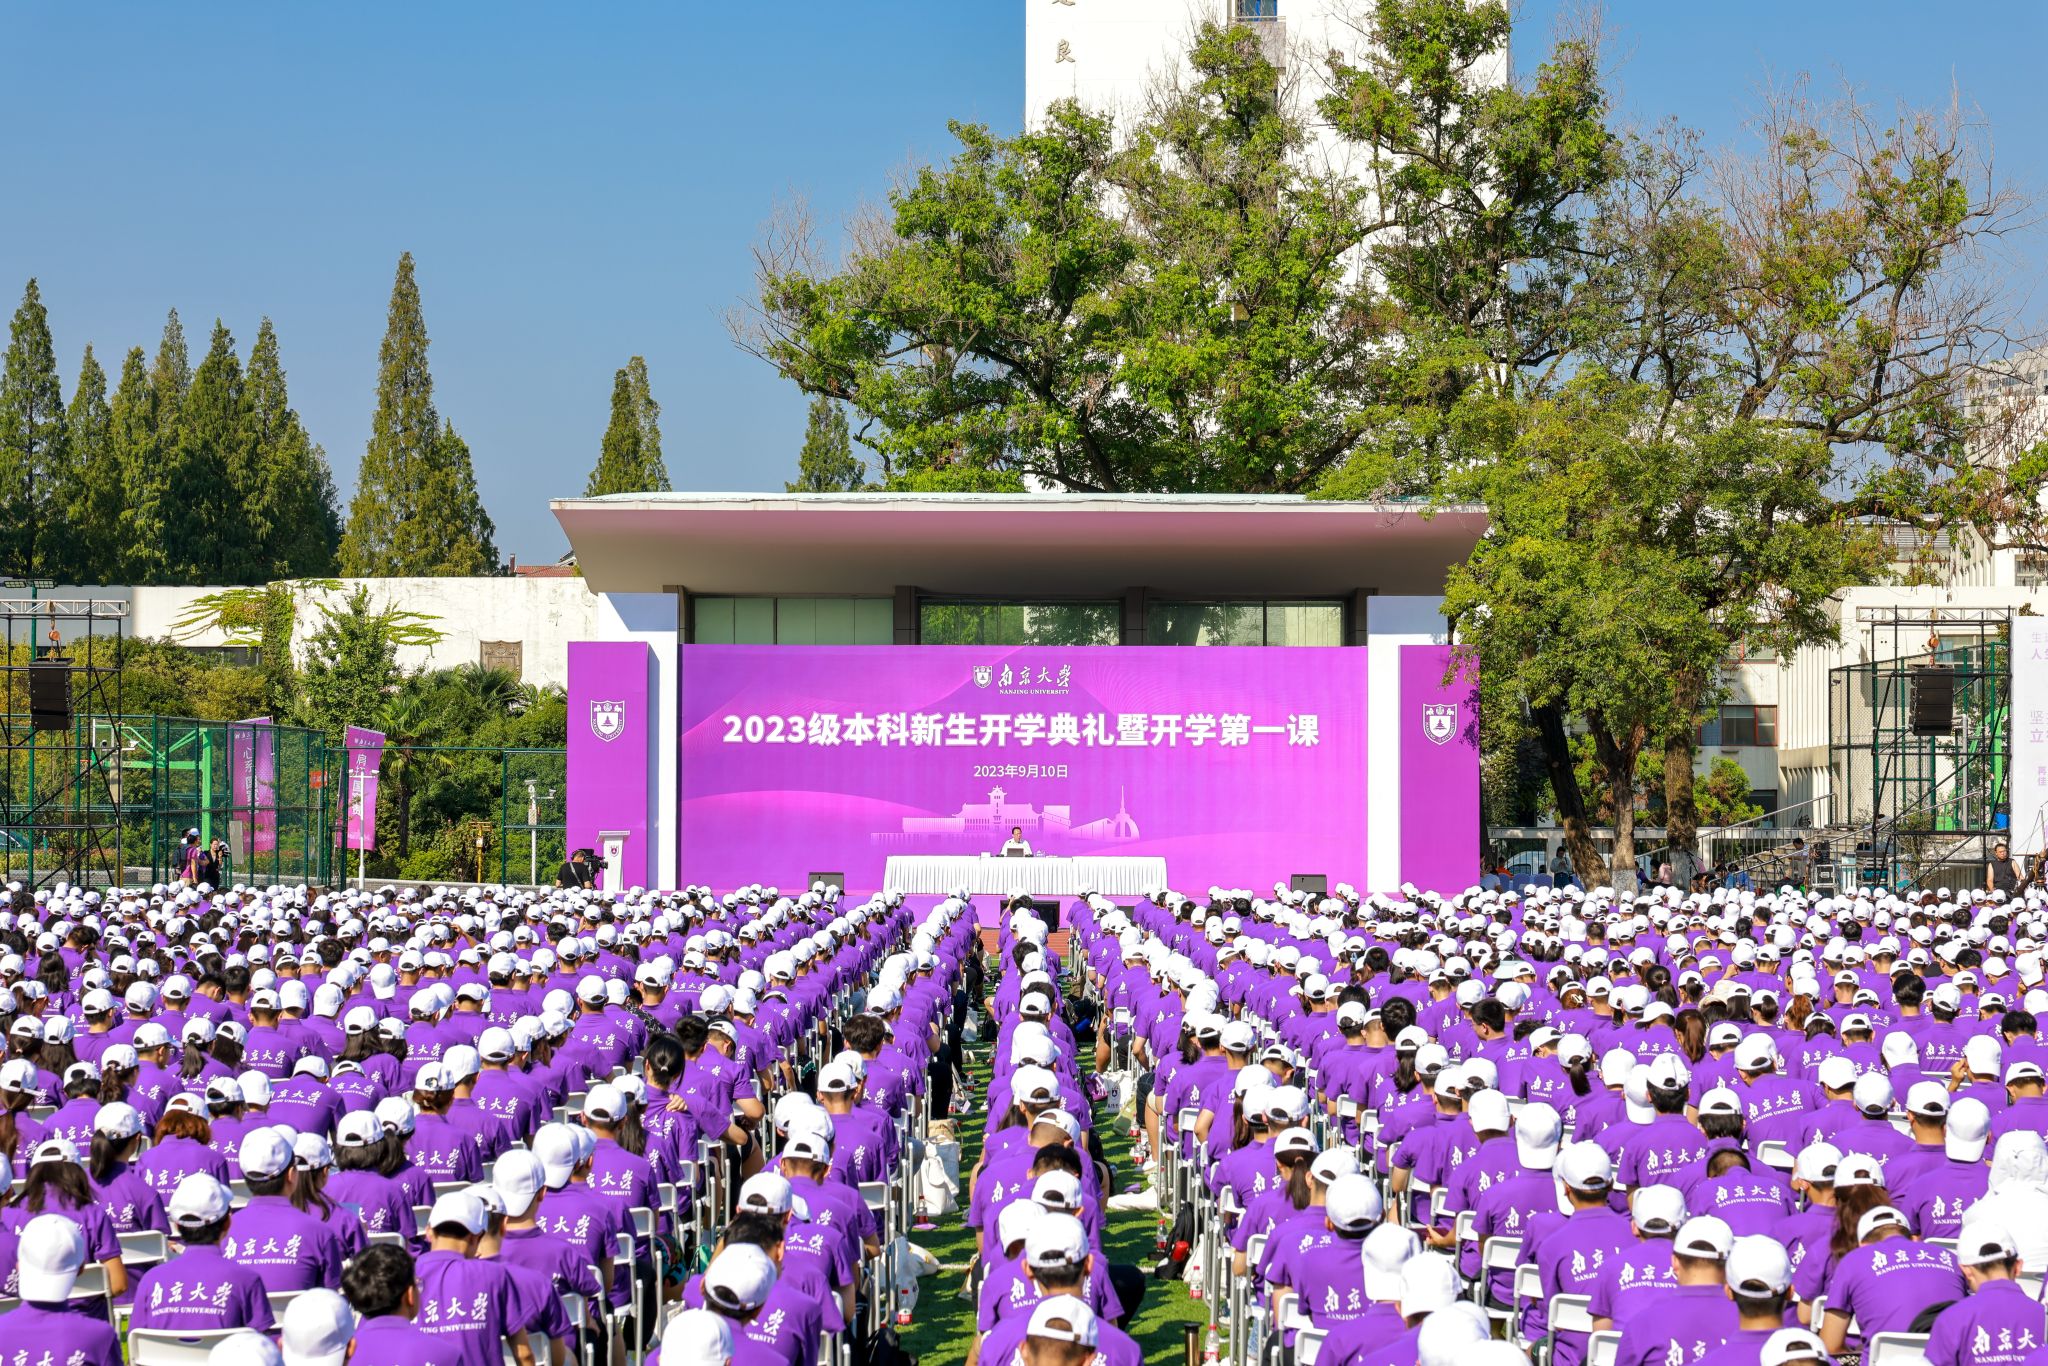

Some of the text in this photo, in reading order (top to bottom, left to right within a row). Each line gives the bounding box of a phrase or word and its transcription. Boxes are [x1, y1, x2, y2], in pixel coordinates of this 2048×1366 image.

[722, 711, 1320, 748] 2023级本科新生开学典礼暨开学第一课
[974, 764, 1068, 778] 2023年9月10日
